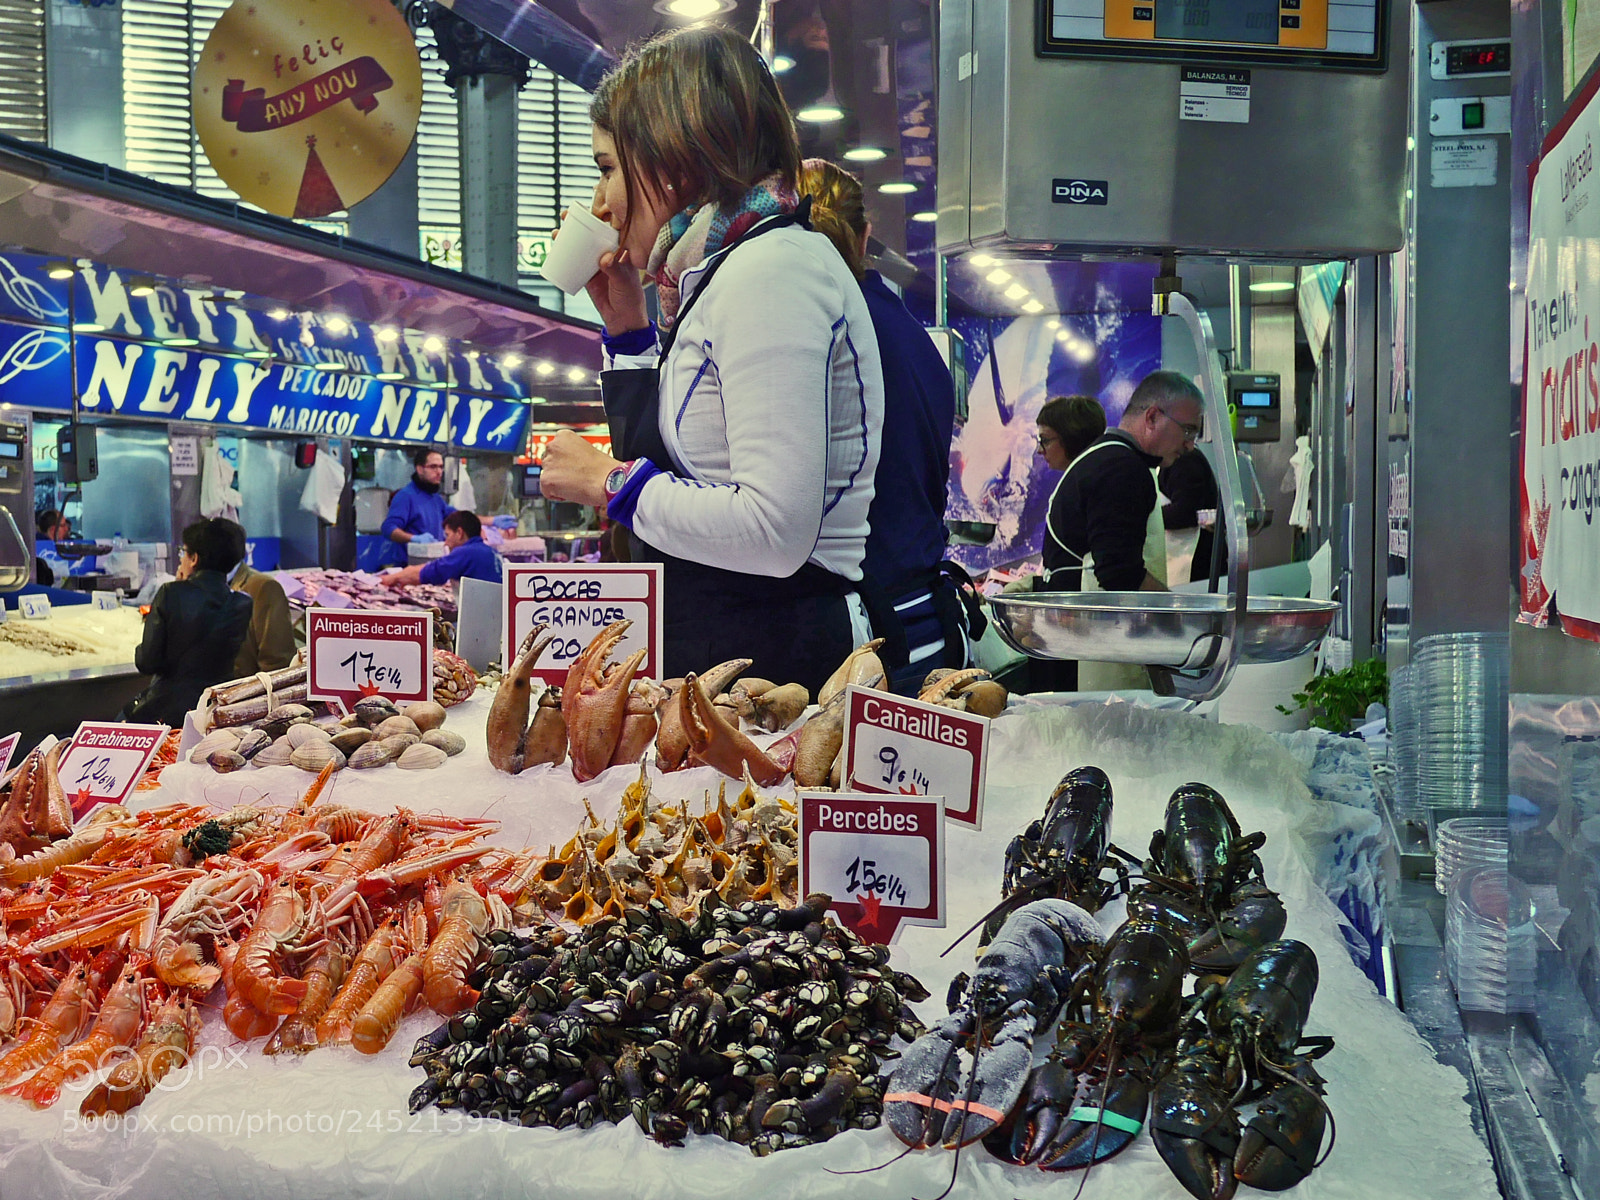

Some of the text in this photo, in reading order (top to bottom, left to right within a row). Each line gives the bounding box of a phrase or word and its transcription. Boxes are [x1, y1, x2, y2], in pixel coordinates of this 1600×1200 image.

[273, 36, 344, 78] feliç
[265, 68, 358, 123] ANY NOU
[1055, 186, 1105, 198] DINA
[81, 340, 271, 423] NELY
[267, 404, 360, 437] MARISCOS
[370, 385, 494, 446] NELY
[527, 575, 602, 603] BOCAS
[314, 617, 422, 637] Almejas de carril
[532, 606, 626, 627] GRANDES
[863, 699, 968, 747] Cañaillas
[78, 729, 155, 749] Carabineros
[818, 804, 919, 832] Percebes
